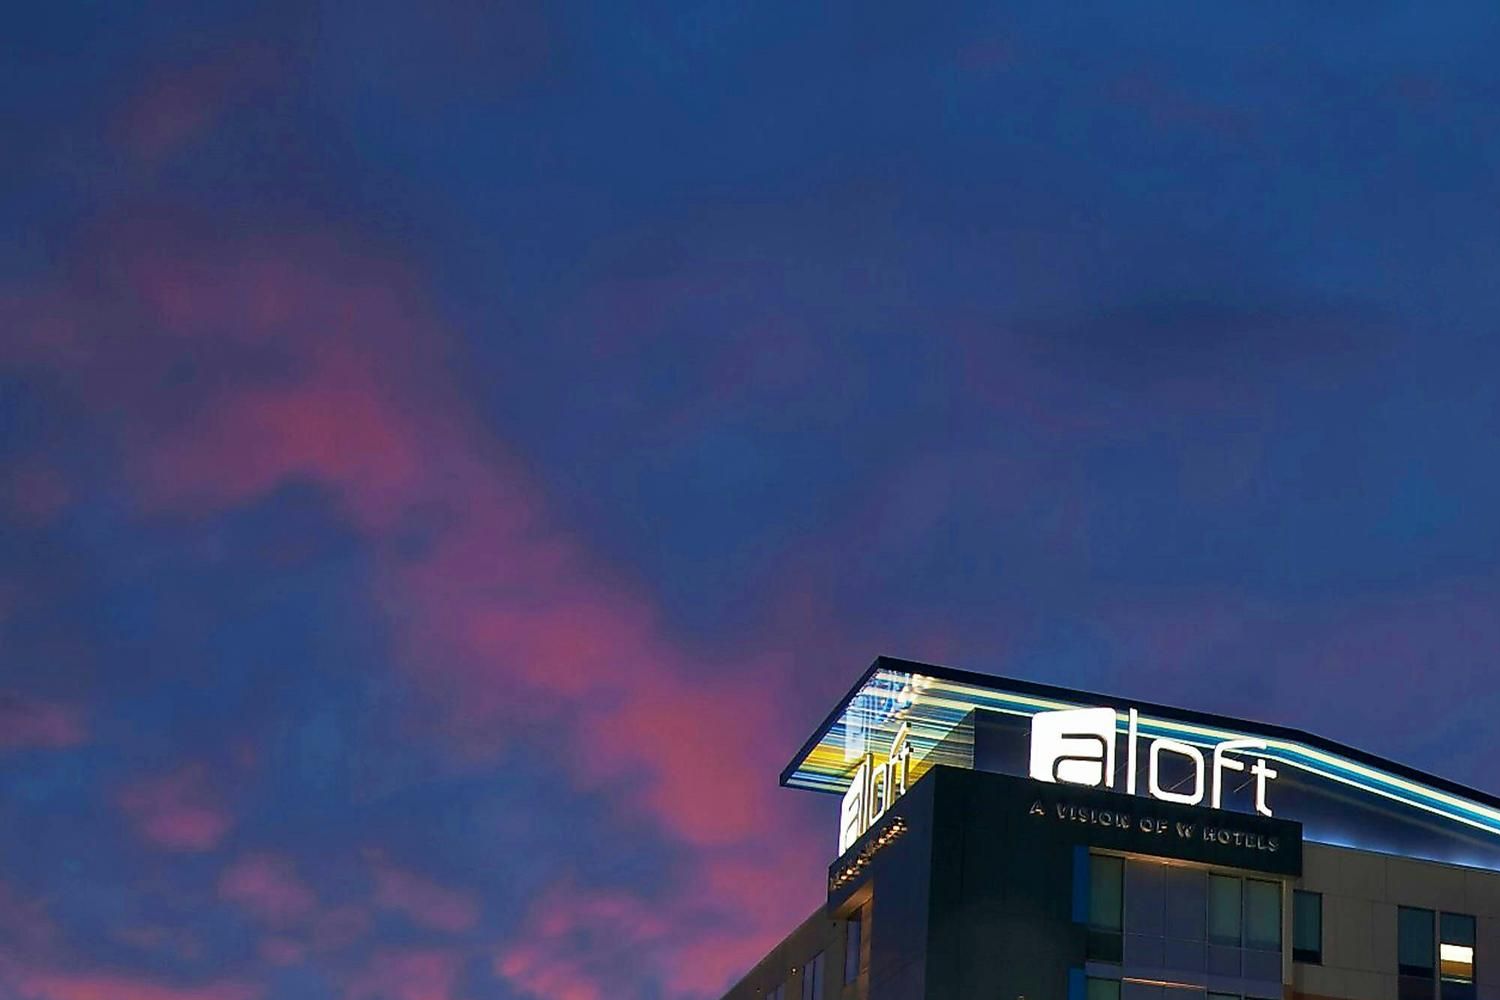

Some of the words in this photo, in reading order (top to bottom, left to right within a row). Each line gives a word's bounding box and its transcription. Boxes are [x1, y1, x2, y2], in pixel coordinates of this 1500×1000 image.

[1029, 706, 1278, 817] aloft
[1028, 800, 1047, 817] A
[1055, 802, 1131, 829] VISION
[1139, 818, 1169, 834] OF
[1175, 821, 1198, 840] W
[1202, 826, 1281, 852] HOTELS
